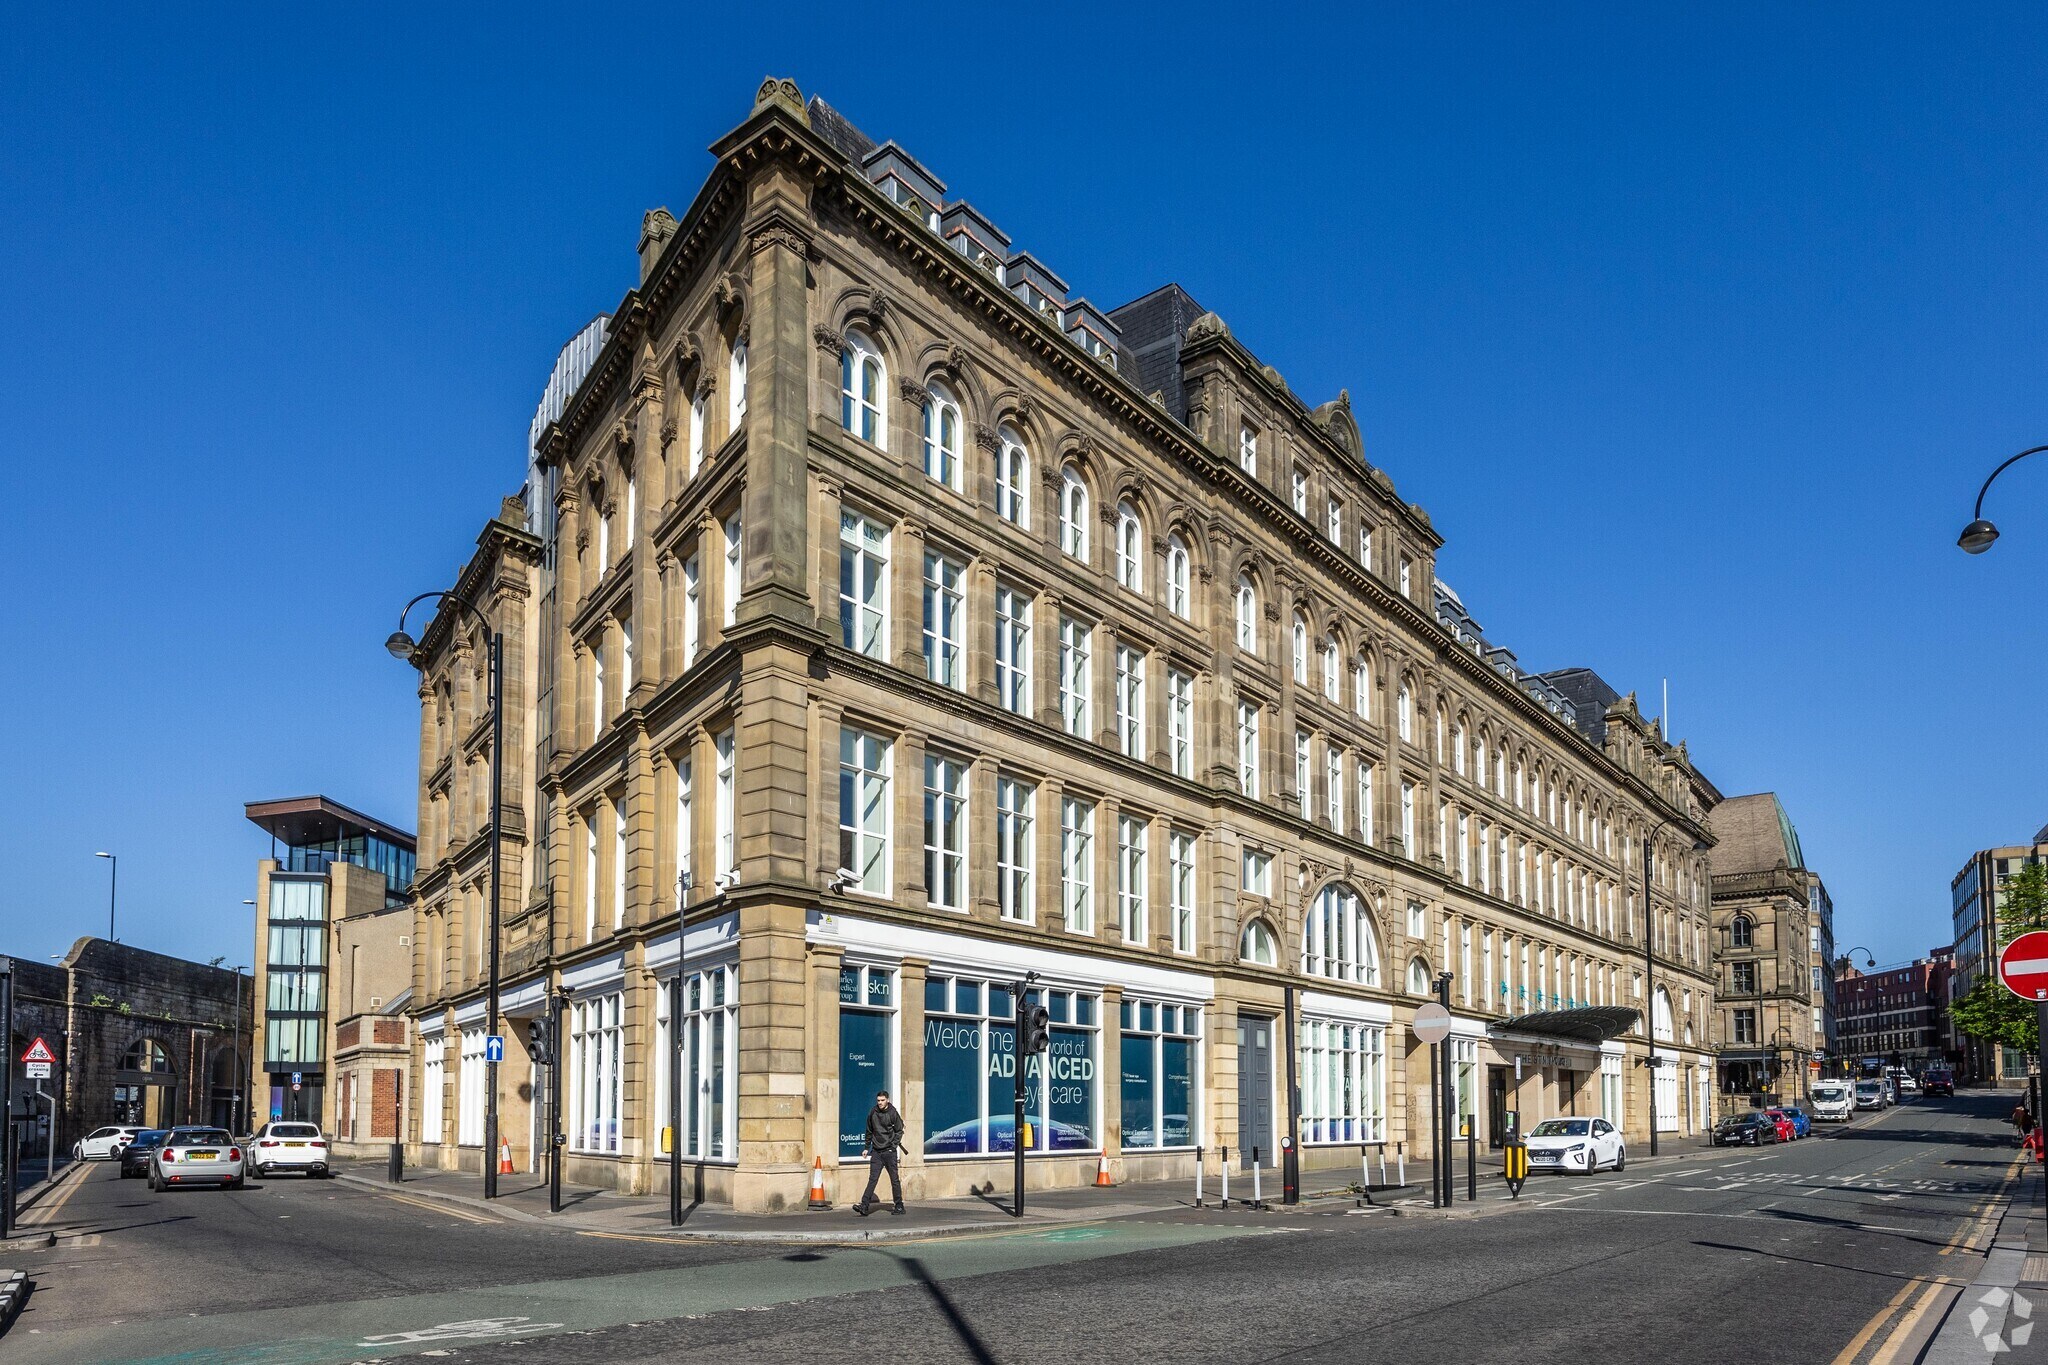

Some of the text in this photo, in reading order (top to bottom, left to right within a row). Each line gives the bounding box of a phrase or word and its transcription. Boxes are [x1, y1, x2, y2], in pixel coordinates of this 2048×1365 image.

[840, 984, 859, 992] edical
[924, 1020, 1013, 1051] Welcome
[1075, 1040, 1085, 1056] of
[849, 1052, 866, 1061] Expert
[840, 1133, 861, 1142] Optical
